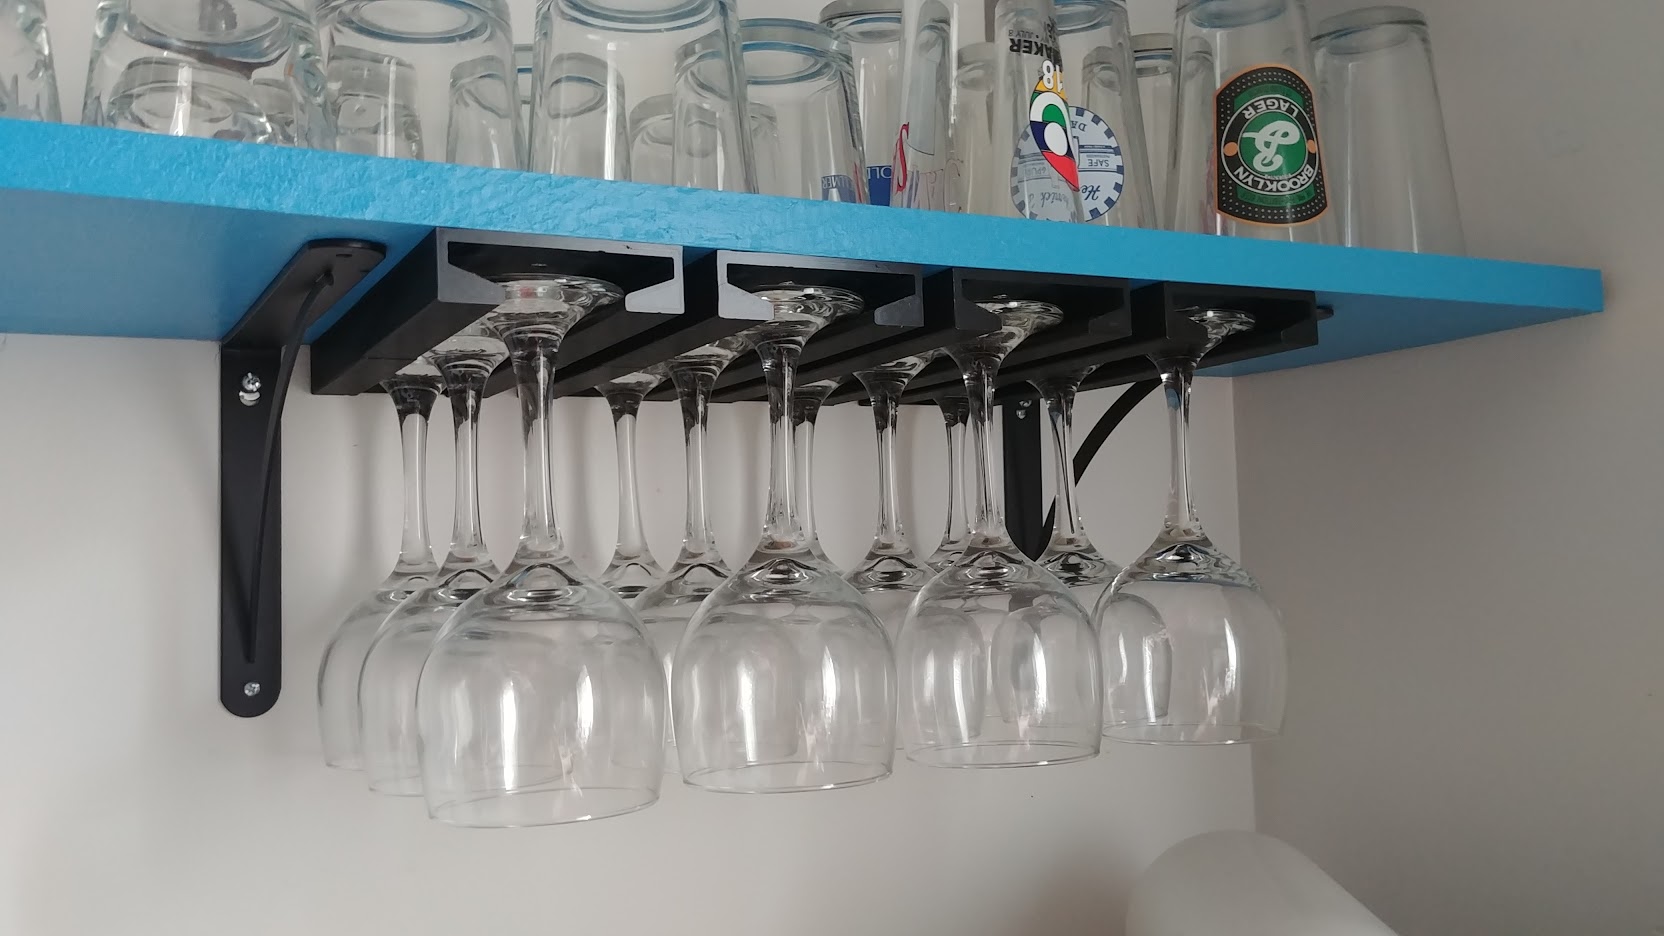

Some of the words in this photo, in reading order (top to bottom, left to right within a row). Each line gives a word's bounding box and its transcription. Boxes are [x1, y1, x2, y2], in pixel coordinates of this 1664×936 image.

[1242, 98, 1301, 120] LAGER
[1088, 158, 1110, 168] SAFE
[1234, 163, 1314, 192] BROOKLYN
